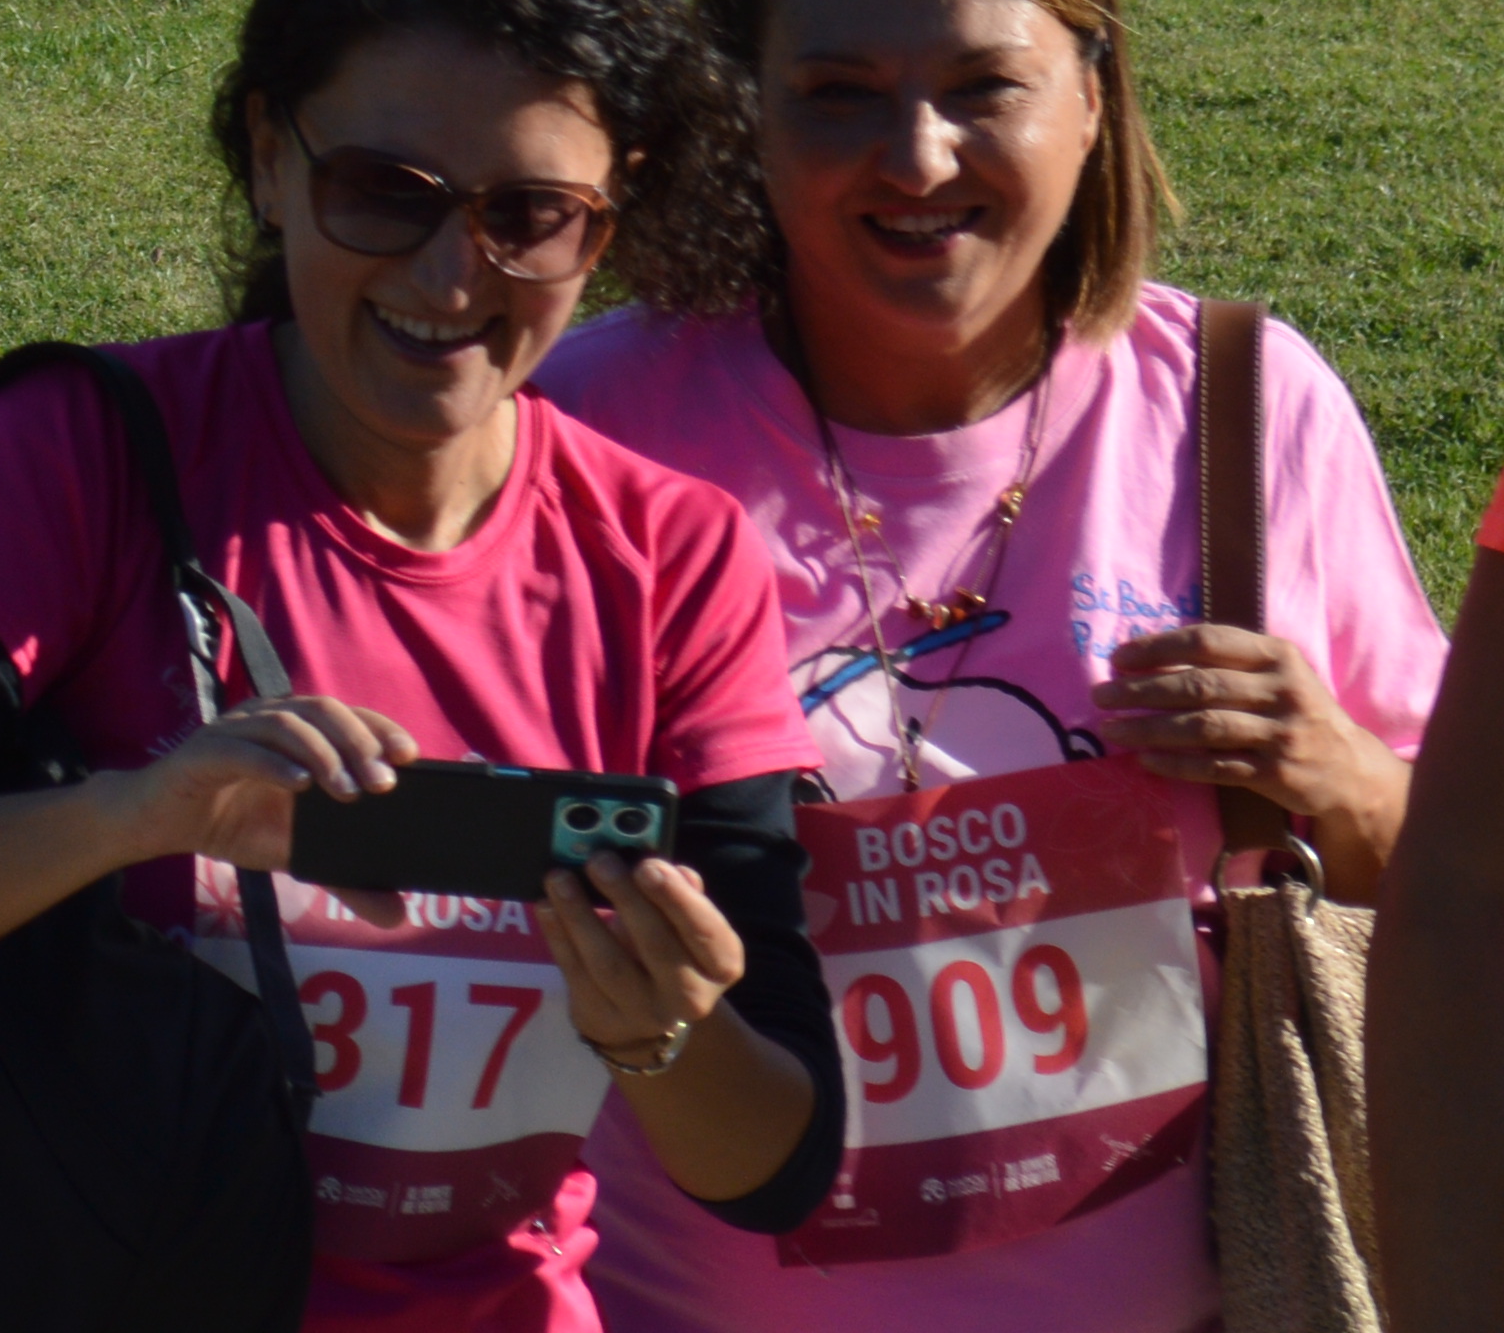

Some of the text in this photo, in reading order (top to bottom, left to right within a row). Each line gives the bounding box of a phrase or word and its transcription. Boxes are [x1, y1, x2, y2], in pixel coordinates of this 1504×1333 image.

[845, 852, 1053, 925] IN ROSA
[855, 801, 1028, 874] BOSCO
[299, 969, 545, 1110] 317
[842, 942, 1090, 1105] 909
